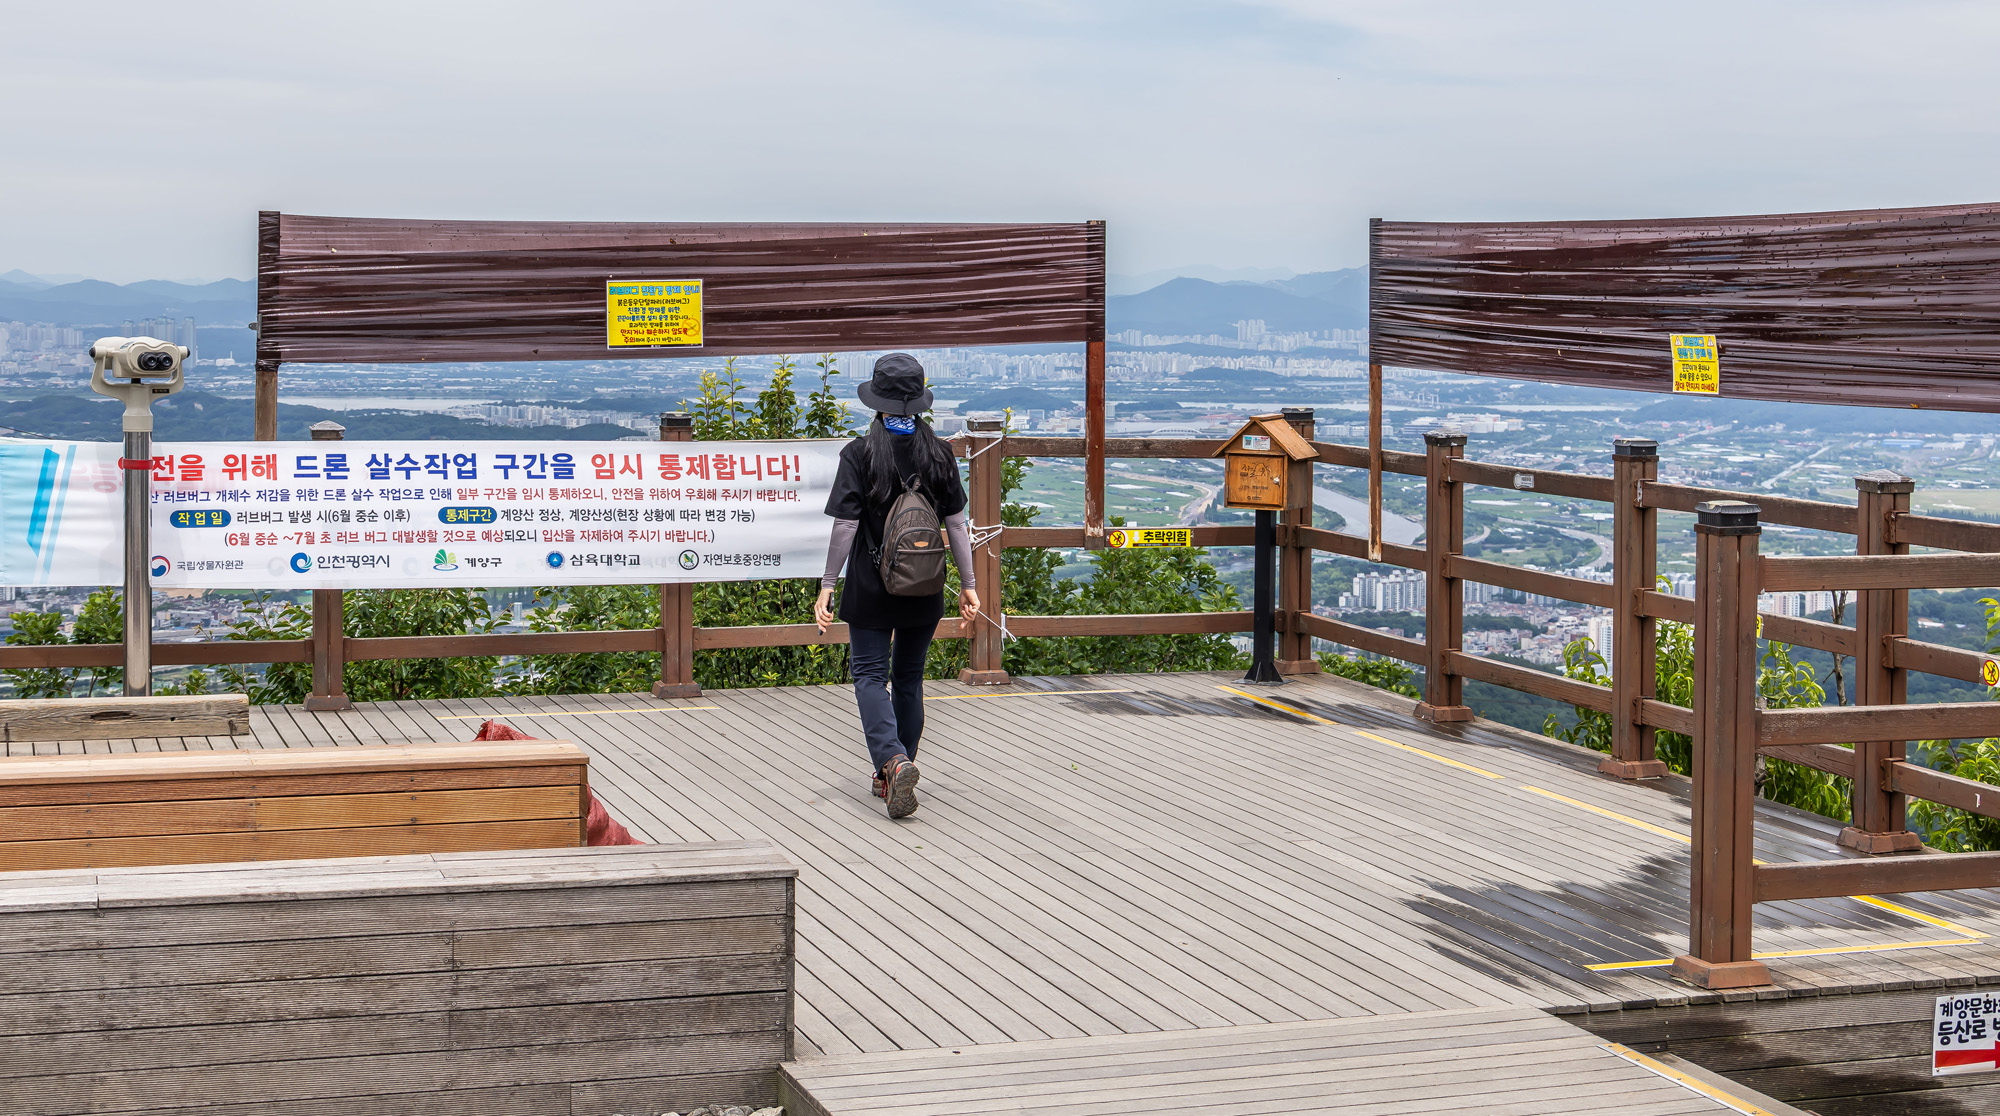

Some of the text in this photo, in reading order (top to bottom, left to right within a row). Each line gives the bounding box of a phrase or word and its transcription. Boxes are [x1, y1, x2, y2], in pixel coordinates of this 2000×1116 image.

[609, 285, 700, 296] 러브버그 친환경 방제 안내
[628, 306, 646, 314] 친환경
[620, 328, 644, 336] 만지거나
[1683, 336, 1705, 347] 러브버그
[1677, 347, 1694, 359] 친환경
[1696, 373, 1699, 381] 수
[1675, 381, 1718, 392] 절대 만지지 마세요!
[221, 453, 278, 481] 위해
[293, 453, 350, 480] 드론
[365, 453, 478, 480] 살수작업
[493, 453, 576, 480] 구간을
[591, 453, 643, 480] 임시
[658, 453, 801, 482] 통제합니다!
[164, 490, 211, 503] 러브버그
[216, 489, 251, 503] 개체수
[256, 488, 291, 502] 저감을
[296, 489, 319, 501] 위한
[323, 488, 347, 501] 드론
[351, 488, 374, 501] 살수
[379, 488, 425, 501] 작업으로
[429, 488, 452, 501] 인해
[457, 488, 479, 501] 일부
[483, 488, 517, 500] 구간을
[522, 488, 544, 500] 임시
[548, 488, 607, 501] 통제하오니,
[611, 488, 644, 500] 안전을
[649, 488, 681, 501] 위하여
[685, 488, 717, 501] 우회해
[720, 488, 752, 502] 주시기
[756, 489, 801, 502] 바랍니다.
[237, 511, 283, 524] 러브버그
[288, 510, 312, 523] 발생
[316, 509, 351, 524] 시(6월
[355, 510, 379, 522] 중순
[383, 509, 411, 523] 이후)
[445, 508, 755, 523] 통제구간 계양산 정상, 계양산성(현장 상황에 따라 변경 가능)
[224, 532, 250, 547] (6월
[254, 532, 278, 546] 중순
[320, 531, 332, 544] 초
[336, 531, 360, 544] 러브
[364, 530, 388, 544] 버그
[392, 530, 438, 543] 대발생할
[443, 530, 477, 543] 것으로
[481, 529, 537, 543] 예상되오니
[542, 529, 576, 543] 입산을
[579, 529, 624, 542] 자제하여
[628, 529, 660, 543] 주시기
[664, 529, 715, 544] 바랍니다.)
[1143, 530, 1187, 542] 추락위험
[176, 560, 244, 571] 국립생물자원관
[317, 554, 390, 569] 인천광역시
[464, 557, 503, 568] 계양구
[569, 553, 641, 567] 삼육대학교
[702, 553, 782, 567] 자연보호중앙연맹
[1939, 998, 2000, 1019] 계양문화
[1938, 1019, 1987, 1046] 등산로
